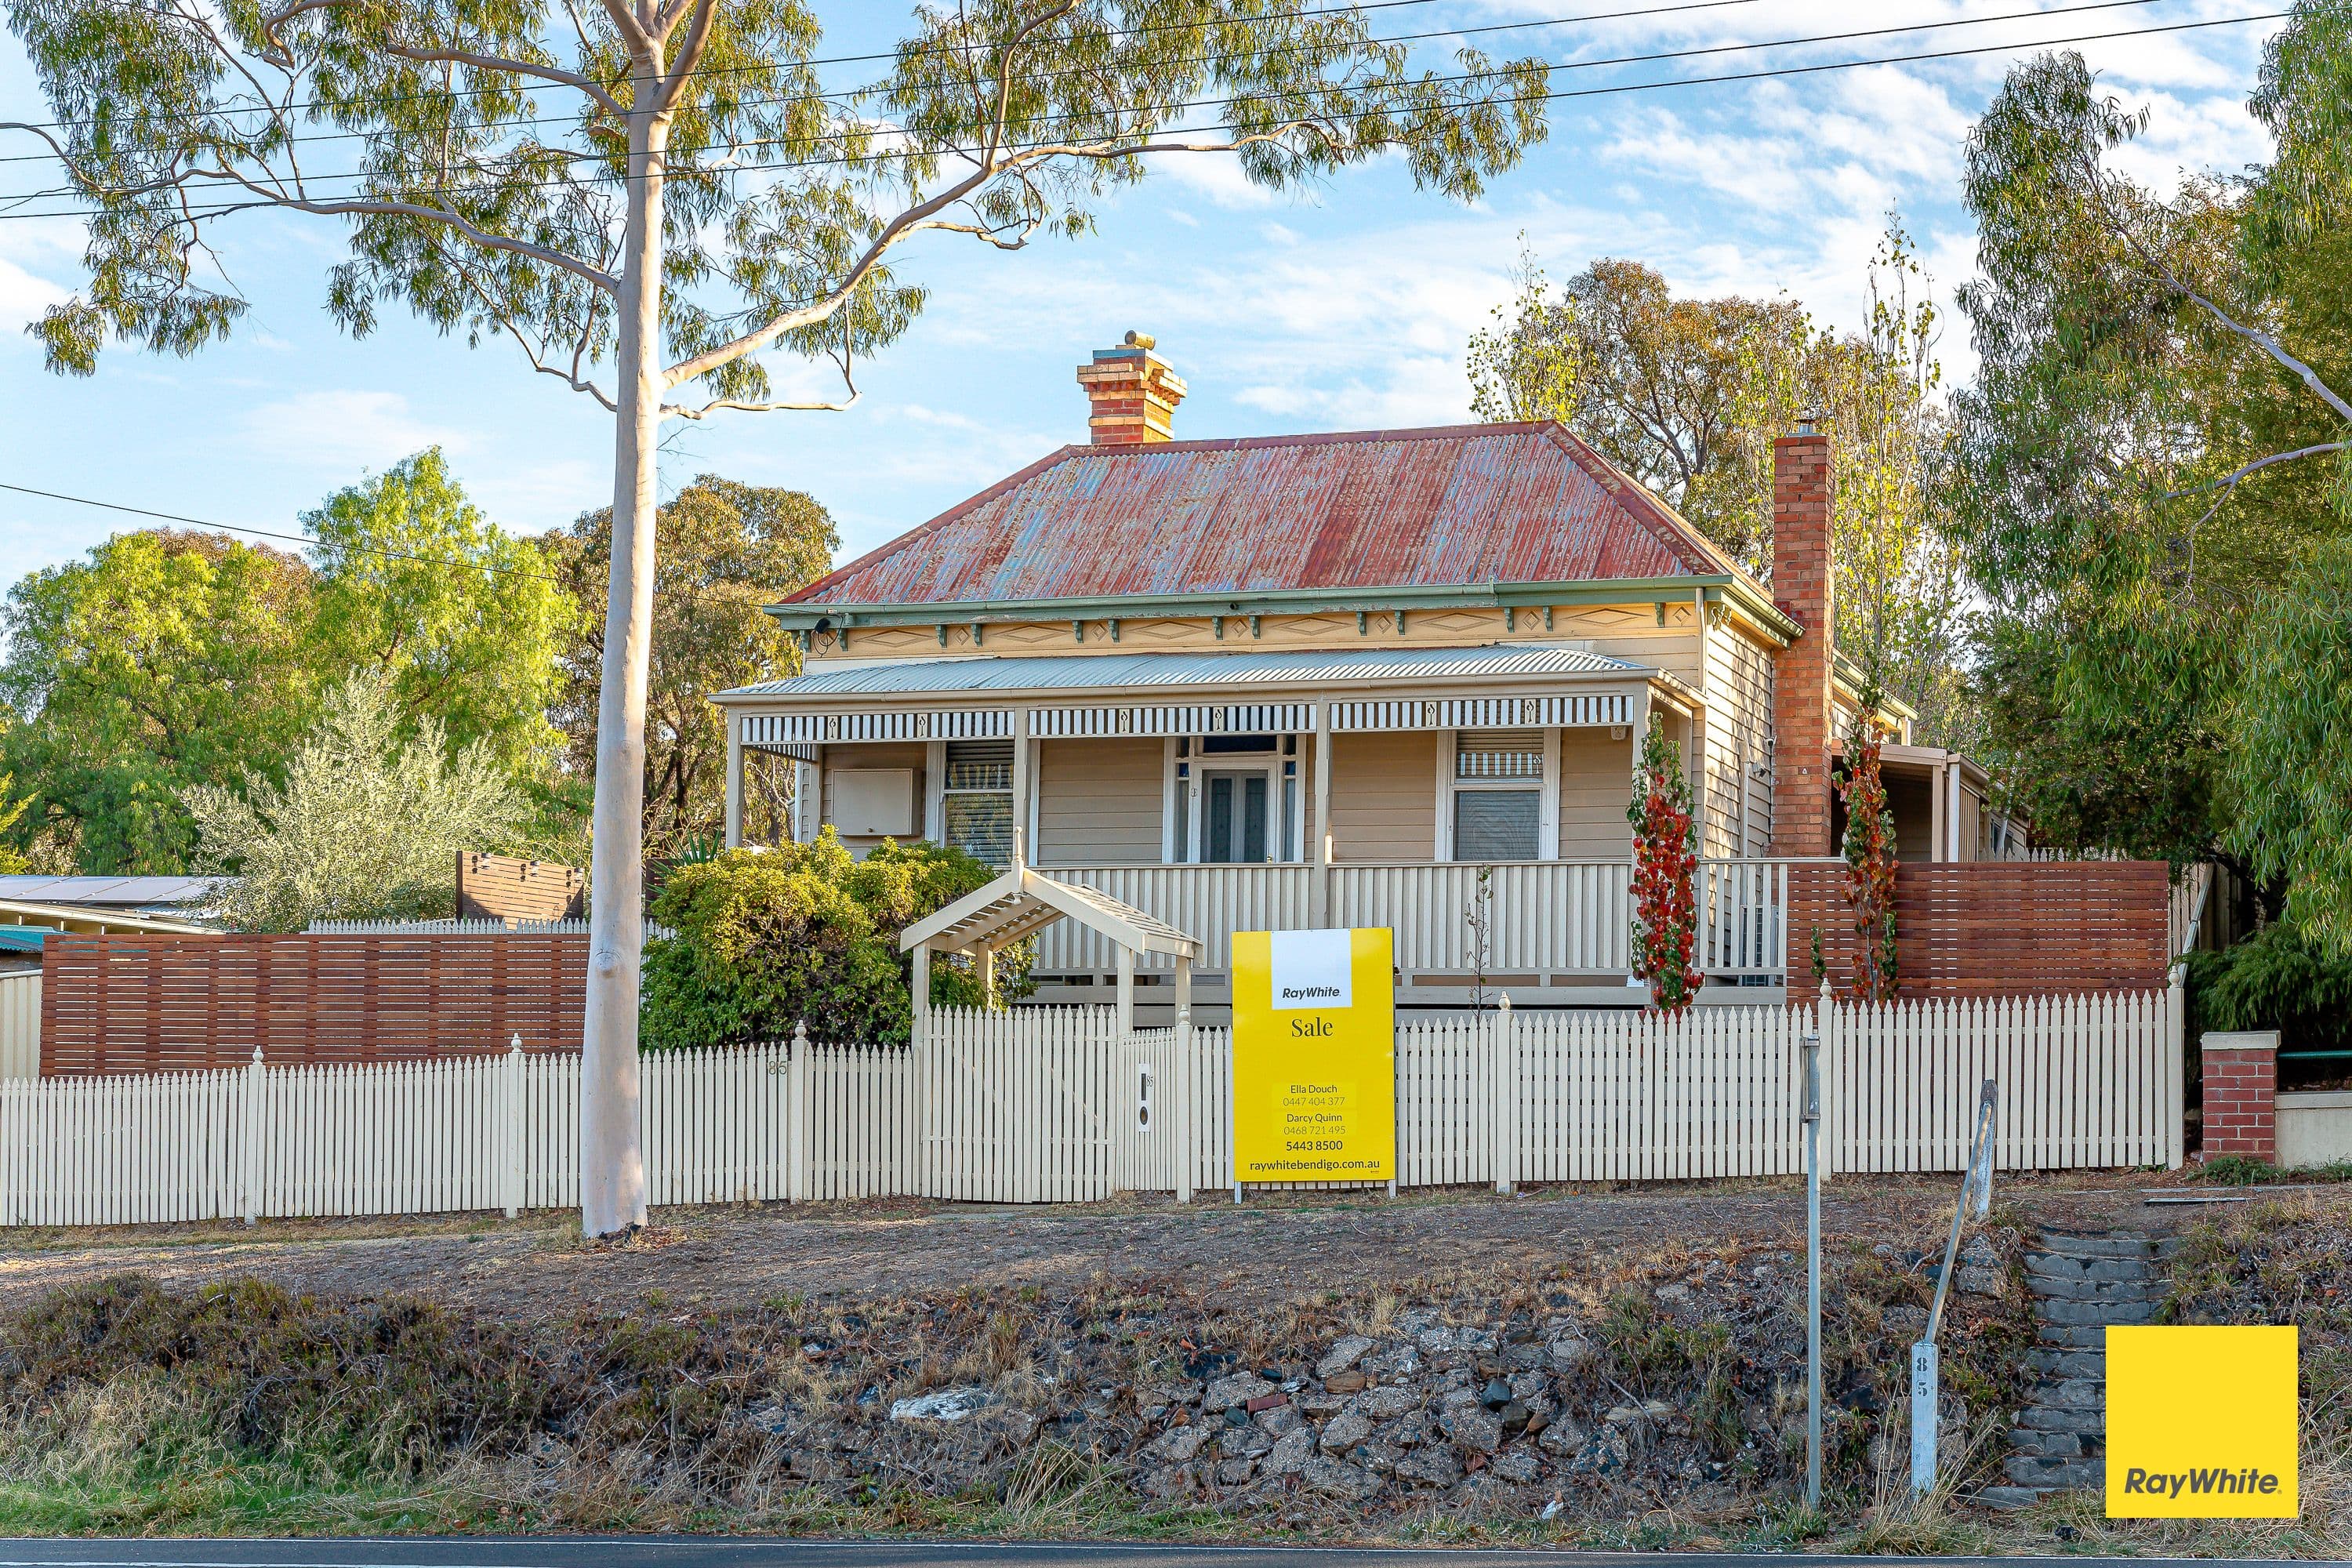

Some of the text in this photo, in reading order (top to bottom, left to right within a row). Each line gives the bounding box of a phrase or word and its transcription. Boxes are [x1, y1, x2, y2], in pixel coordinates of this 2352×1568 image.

[1291, 1017, 1334, 1037] Sale
[769, 1061, 787, 1075] 85
[1290, 1084, 1338, 1094] Ella Douch
[1283, 1097, 1345, 1106] 0447 404 377
[1287, 1113, 1343, 1123] Darcy Quinn
[1283, 1126, 1346, 1135] 0468 721 495
[1286, 1141, 1343, 1151] 5443 8500
[1250, 1159, 1381, 1171] raywhitebendigo.com.au
